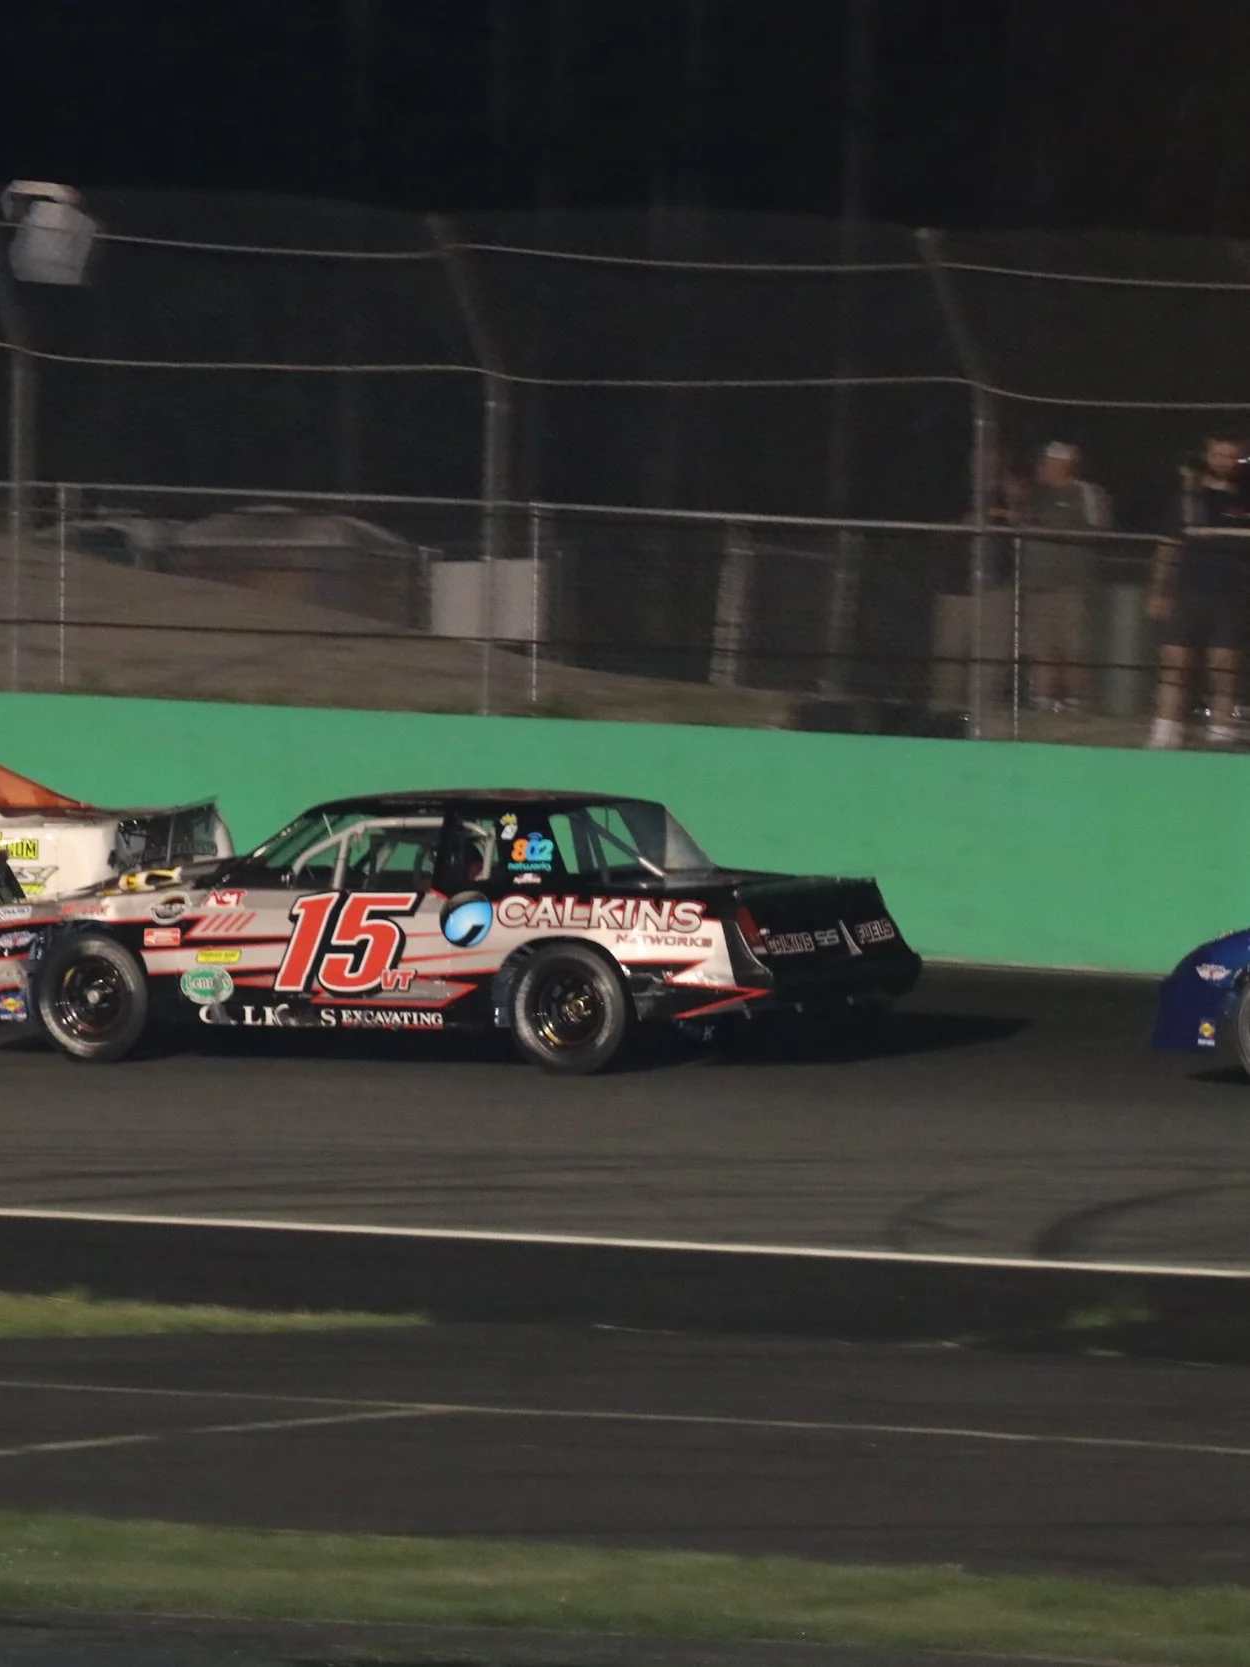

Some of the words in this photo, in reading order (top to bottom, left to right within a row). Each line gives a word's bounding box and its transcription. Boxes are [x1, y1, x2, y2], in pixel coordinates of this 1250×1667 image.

[511, 838, 554, 862] 802
[497, 893, 707, 934] CALKINS
[273, 891, 419, 993] 15
[616, 934, 713, 948] NTWORKS
[765, 932, 816, 955] CALKINS
[854, 919, 895, 945] FUELS
[185, 974, 231, 990] Lenns
[381, 968, 417, 991] VT
[198, 1003, 337, 1027] CLKS
[341, 1008, 444, 1026] EXCAVATING
